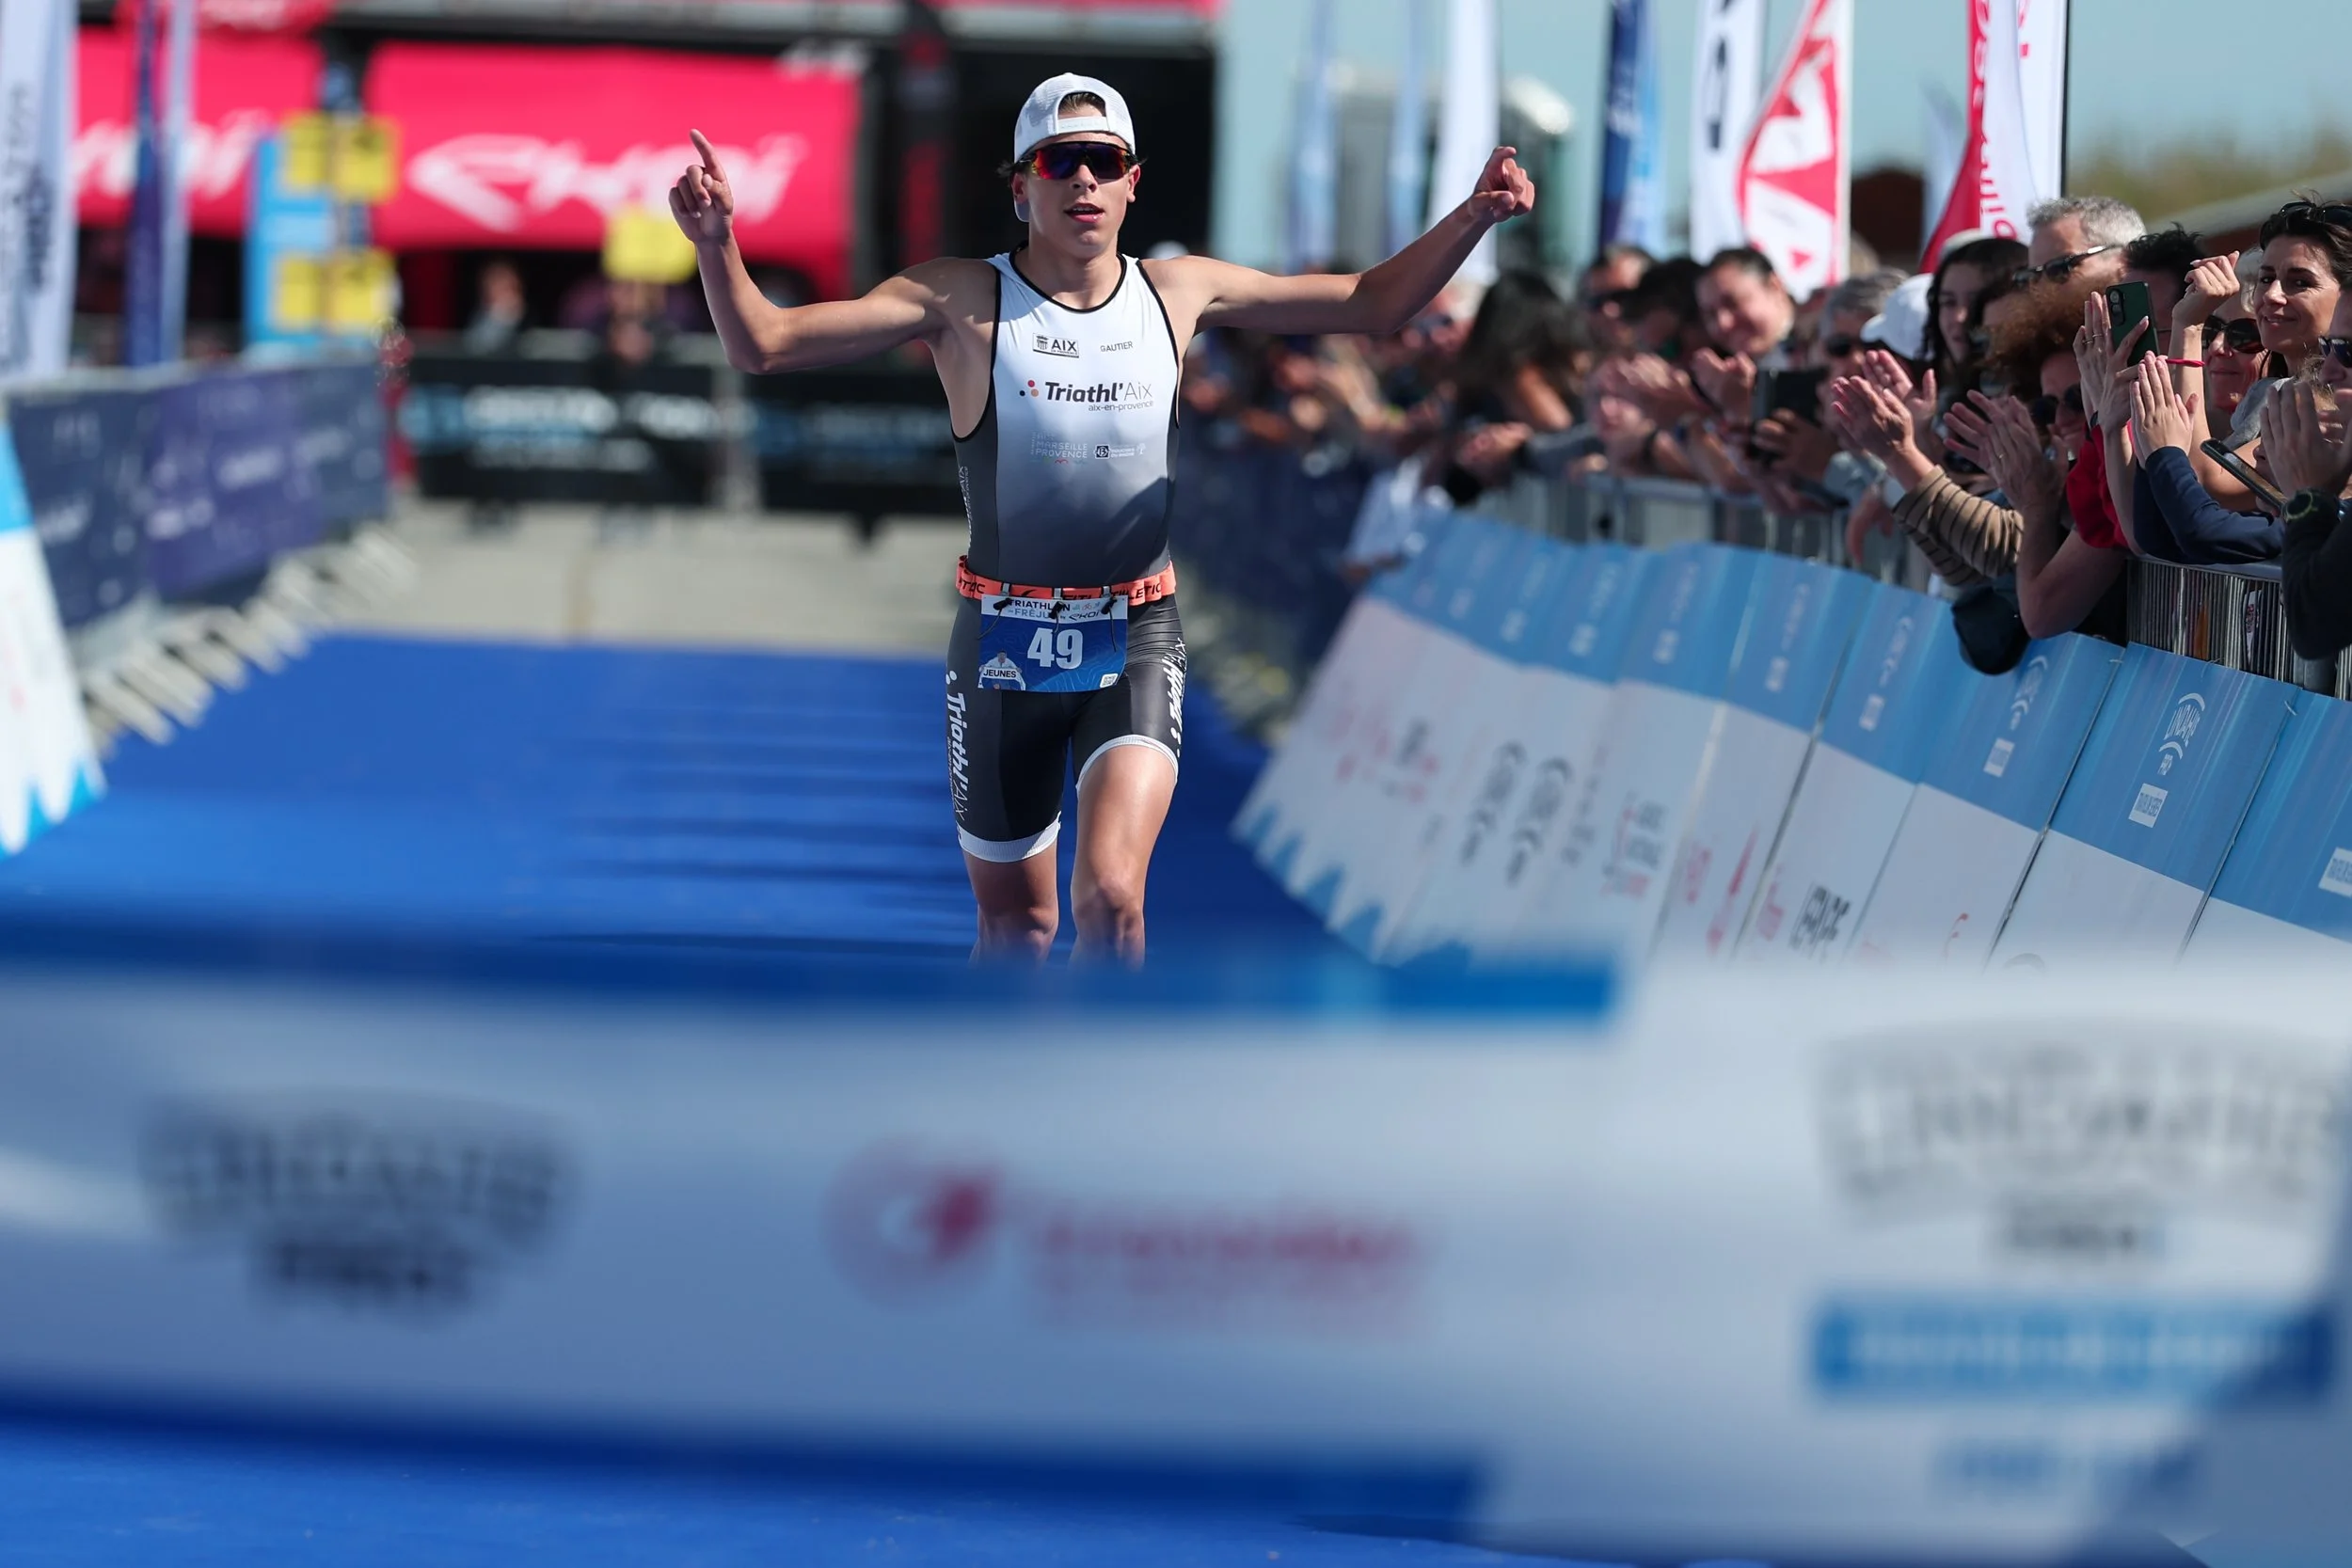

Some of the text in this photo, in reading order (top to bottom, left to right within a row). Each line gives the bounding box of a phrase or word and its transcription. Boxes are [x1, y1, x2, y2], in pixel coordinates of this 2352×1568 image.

[1051, 339, 1077, 352] AIX
[1100, 341, 1133, 352] GAUTIER
[1088, 400, 1153, 412] aix-en-provence
[1036, 441, 1088, 451] MARSEILLE
[1035, 449, 1088, 458] PROVENCE
[1009, 598, 1071, 611] TRIATHLN
[1014, 608, 1053, 619] FRÉJU
[1027, 627, 1083, 670] 49
[983, 669, 1017, 678] JEUNES
